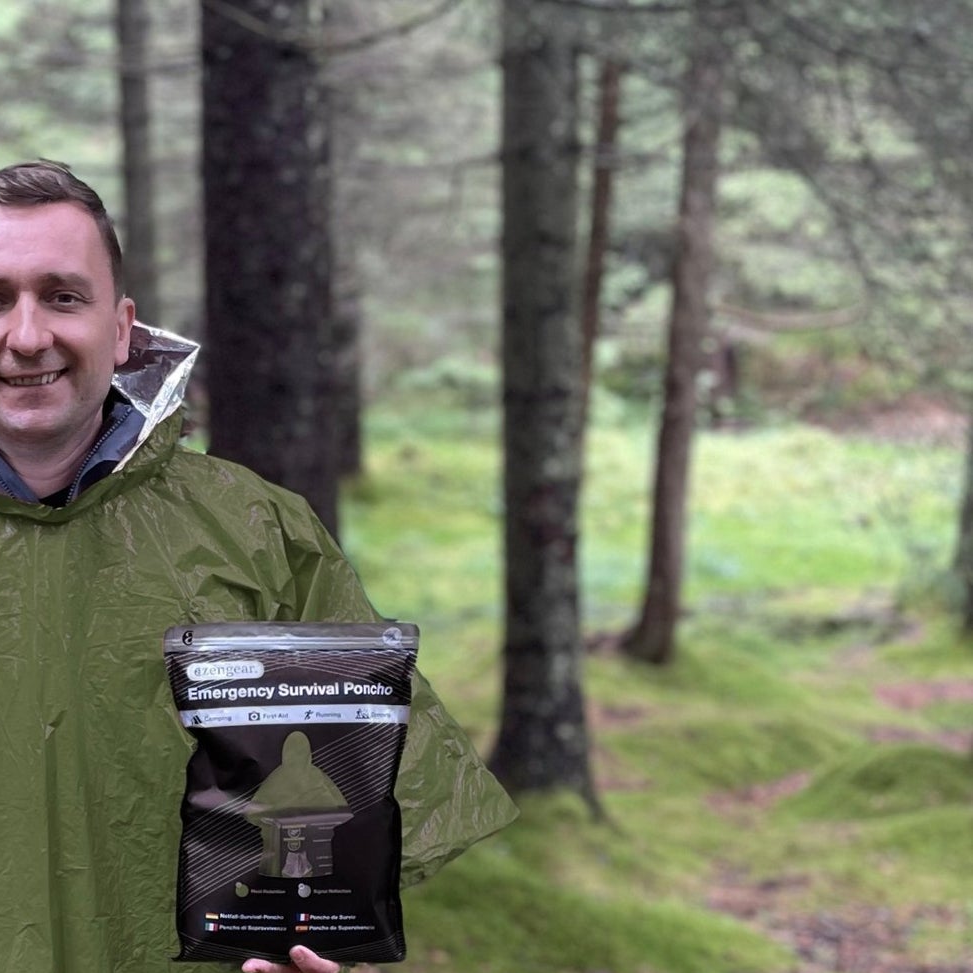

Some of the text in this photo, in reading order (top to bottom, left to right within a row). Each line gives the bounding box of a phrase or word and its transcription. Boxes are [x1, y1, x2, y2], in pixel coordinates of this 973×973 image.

[188, 682, 393, 701] Emergency Survival Poncho
